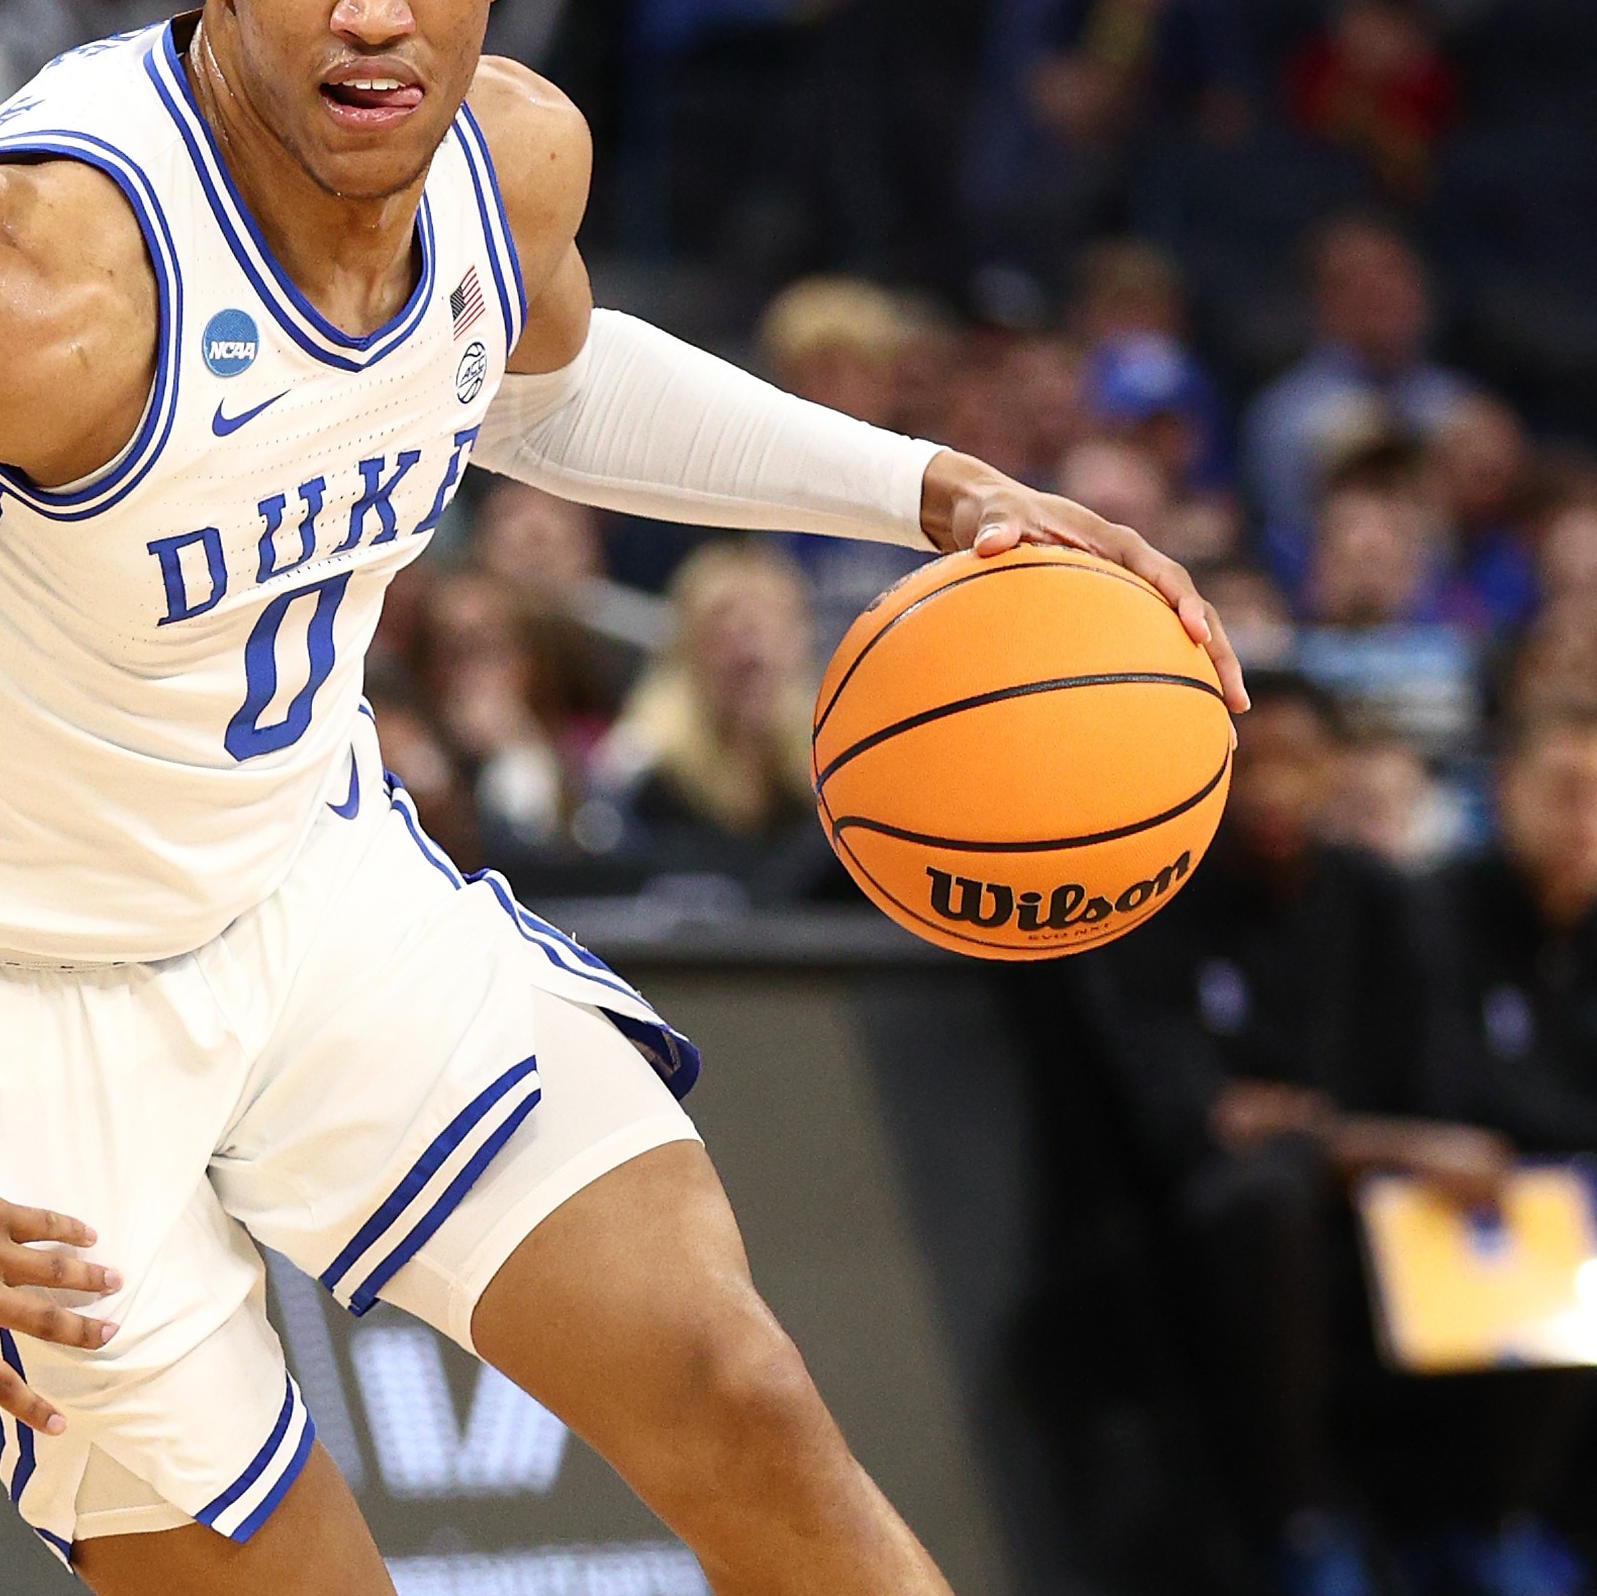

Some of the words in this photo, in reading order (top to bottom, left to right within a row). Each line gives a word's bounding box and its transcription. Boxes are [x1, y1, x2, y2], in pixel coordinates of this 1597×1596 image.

[208, 340, 256, 360] NCAA
[224, 569, 354, 762] 0
[925, 849, 1192, 932] Wilson
